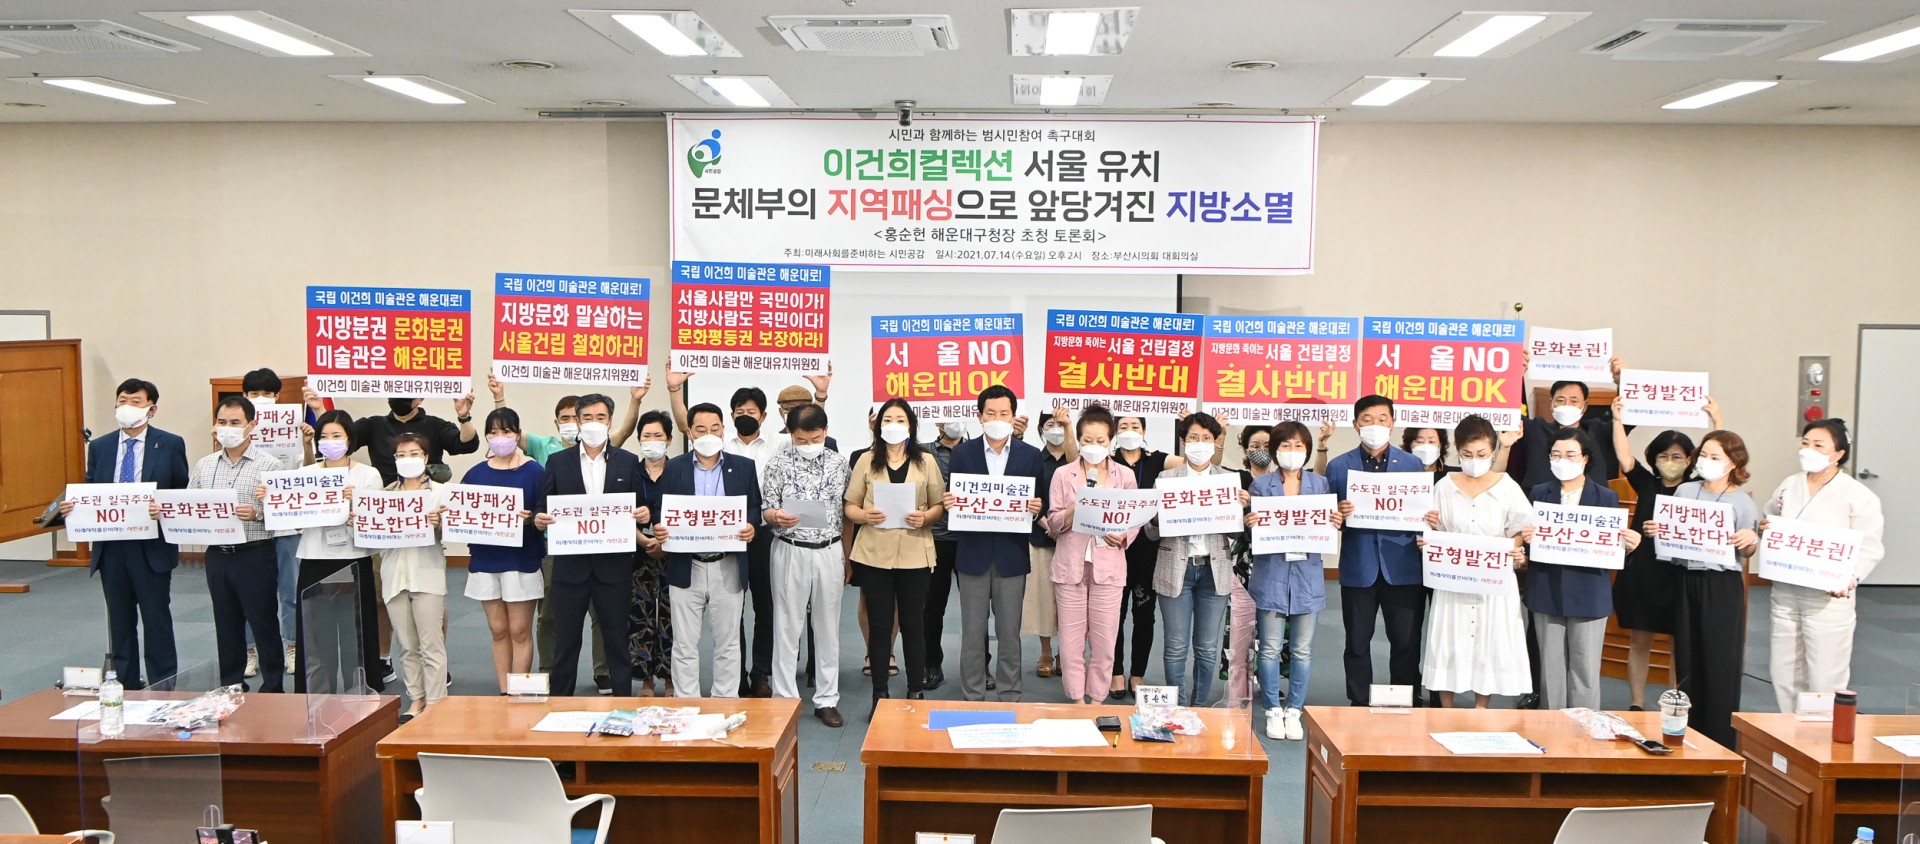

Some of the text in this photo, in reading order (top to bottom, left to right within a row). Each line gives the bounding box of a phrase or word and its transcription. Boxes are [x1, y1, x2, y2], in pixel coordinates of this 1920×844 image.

[889, 129, 1095, 142] 시민과 함께하는 범시민참여 촉구대회
[824, 149, 1159, 182] 이건희컬렉션 서울 유치
[692, 188, 1293, 223] 문체부의 지역패싱으로 앞당겨진 지방소멸
[874, 227, 1106, 243] <홍순헌 해운대구청장 초청 토론회>
[784, 248, 885, 258] 주최:미래사회를준비하는
[890, 249, 925, 259] 시민공감
[1092, 251, 1158, 260] 장소:부산시의회
[1163, 251, 1198, 261] 대회의실
[681, 266, 821, 282] 국립 이건희 미술관은 해운대로!
[504, 278, 642, 295] 국립 이건희 미술관은 해운대로!
[316, 291, 462, 307] 국립 이건희 미술관은 해운대로!
[678, 289, 824, 309] 서울사람만 국민이가!
[501, 302, 642, 329] 지방문화 말살하는
[678, 309, 823, 329] 지방사람도 국민이다!
[1056, 314, 1194, 331] 국립 이건희 미술관은 해운대로!
[316, 316, 463, 341] 지방분권 문화분권
[880, 318, 1014, 333] 국립 이건희 미술관은 해운대로!
[1213, 321, 1350, 335] 국립 이건희 미술관은 해운대로!
[1372, 321, 1515, 337] 국립 이건희 미술관은 해운대로!
[499, 331, 643, 358] 서울건립 철회하라!
[678, 329, 823, 348] 문화평등권 보장하라!
[1054, 336, 1194, 358] 지방문화 죽이는 서울 건립결정
[969, 340, 1011, 365] NO
[1211, 343, 1351, 362] 지방문화 죽이는 서울 건립결정
[1532, 341, 1607, 357] 문화분권!
[316, 346, 463, 370] 미술관은 해운대로
[680, 355, 819, 370] 이건희 미술관 해운대유치위원회
[1463, 347, 1509, 372] NO
[502, 365, 639, 382] 이건희 미술관 해운대유치위원회
[1058, 361, 1188, 393] 결사반대
[317, 380, 462, 393] 이건희 미술관 해운대유치위원회
[886, 371, 961, 398] 해운대
[1217, 369, 1347, 399] 결사반대
[1375, 374, 1507, 403] 해운대 OK
[1624, 383, 1703, 401] 균형발전!
[1243, 408, 1270, 420] 미술관
[1274, 408, 1348, 422] 해운대유치위원회
[1401, 410, 1429, 423] 미술관
[249, 427, 298, 442] 한다!
[267, 475, 344, 489] 이건희미술관
[955, 481, 1030, 496] 이건희미술관
[1350, 483, 1430, 495] 수도권 일극주의
[268, 490, 345, 510] 부산으로!
[358, 497, 423, 514] 지방패싱
[450, 491, 515, 511] 지방패싱
[954, 497, 1029, 513] 부산으로!
[1079, 498, 1158, 509] 수도권 일극주의
[1162, 487, 1237, 509] 문화분권!
[1375, 498, 1403, 511] NO!
[97, 509, 125, 523] NO!
[160, 503, 235, 519] 문화분권!
[446, 510, 519, 529] 분노한다!
[551, 506, 632, 517] 수도권 일극주의
[665, 510, 742, 526] 균형발전!
[1103, 512, 1130, 524] NO!
[1538, 510, 1622, 529] 이건희미술관
[1659, 503, 1724, 527] 지방패싱
[356, 515, 428, 533] 분노한다!
[577, 520, 605, 534] NO!
[1536, 526, 1621, 546] 부산으로!
[1767, 531, 1854, 562] 문화분권!
[1427, 545, 1508, 569] 균형발전!
